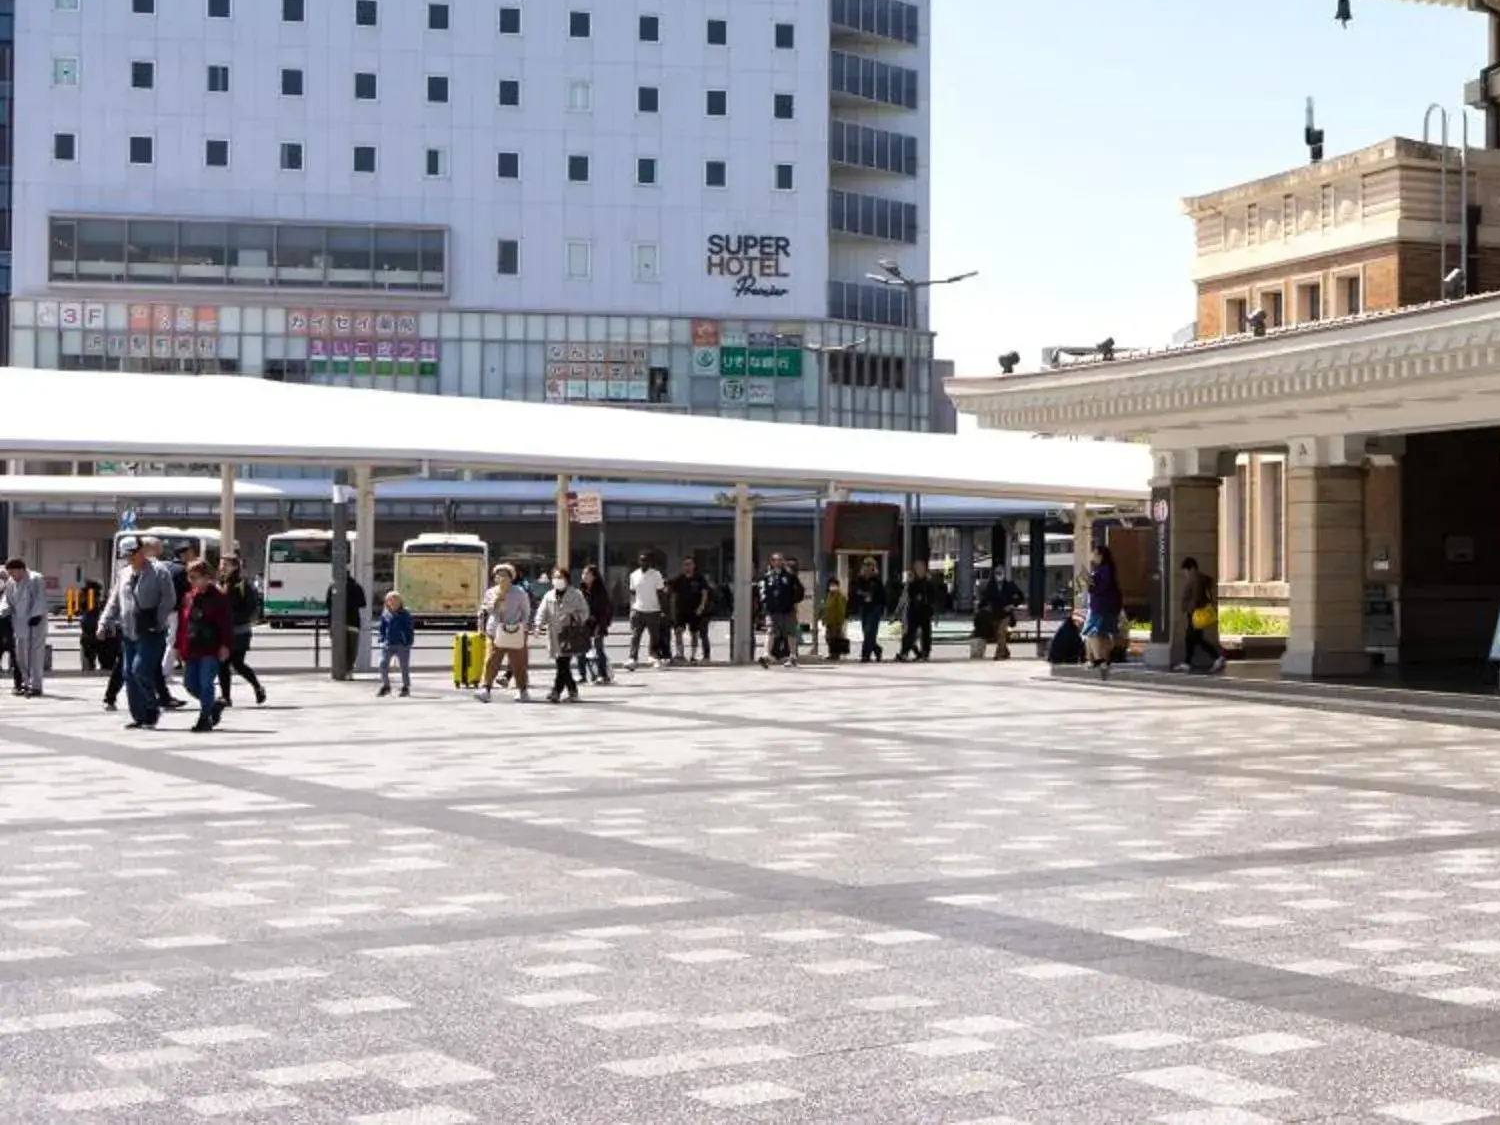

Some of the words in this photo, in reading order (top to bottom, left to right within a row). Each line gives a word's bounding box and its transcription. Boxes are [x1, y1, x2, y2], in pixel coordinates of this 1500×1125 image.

[707, 234, 790, 257] SUPER
[707, 256, 790, 277] HOTEL
[732, 275, 789, 297] Premier
